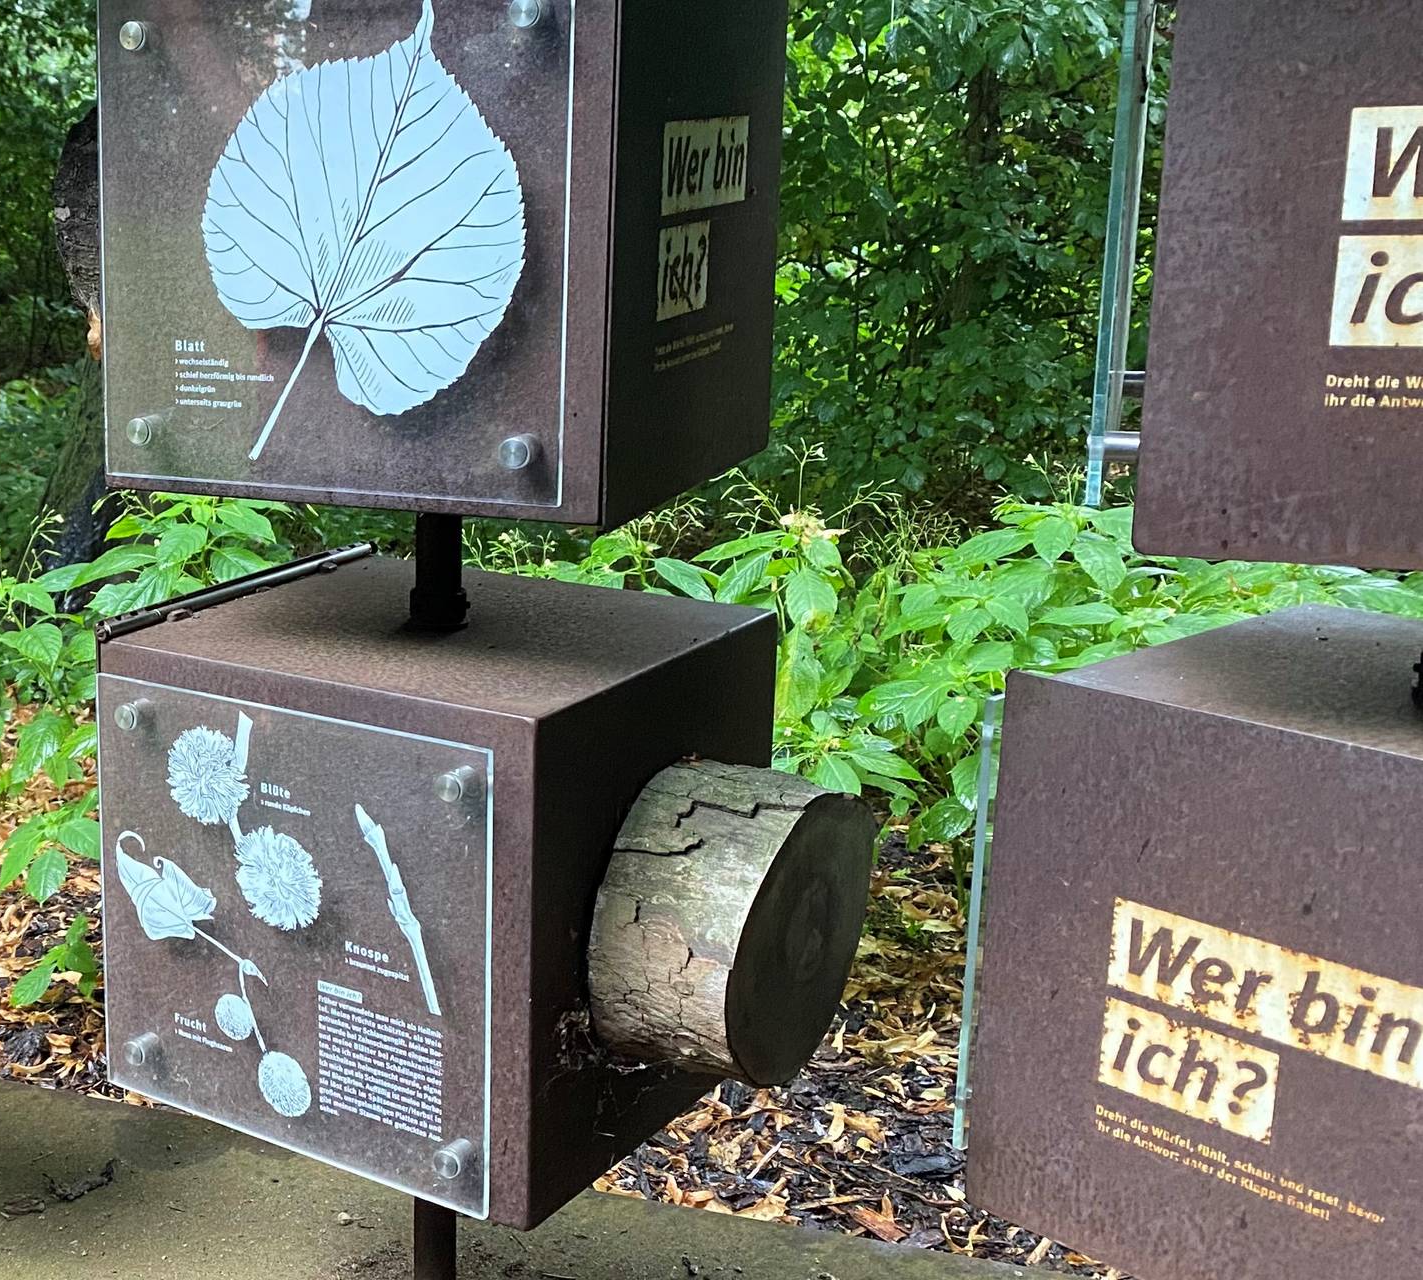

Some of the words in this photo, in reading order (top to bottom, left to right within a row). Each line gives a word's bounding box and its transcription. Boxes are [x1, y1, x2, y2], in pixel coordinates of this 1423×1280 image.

[667, 136, 710, 198] Wer
[713, 128, 745, 190] bin
[661, 235, 706, 303] ich?
[175, 340, 205, 352] Blatt
[1326, 374, 1370, 388] Dreht
[1375, 375, 1399, 388] die
[1351, 394, 1376, 406] die
[1380, 395, 1423, 407] Antw
[261, 782, 290, 799] Blüte
[345, 940, 389, 963] Knospe
[1128, 918, 1273, 1012] Wer
[1289, 971, 1423, 1064] bin
[174, 1012, 207, 1033] Frucht
[1113, 1017, 1267, 1115] ich?
